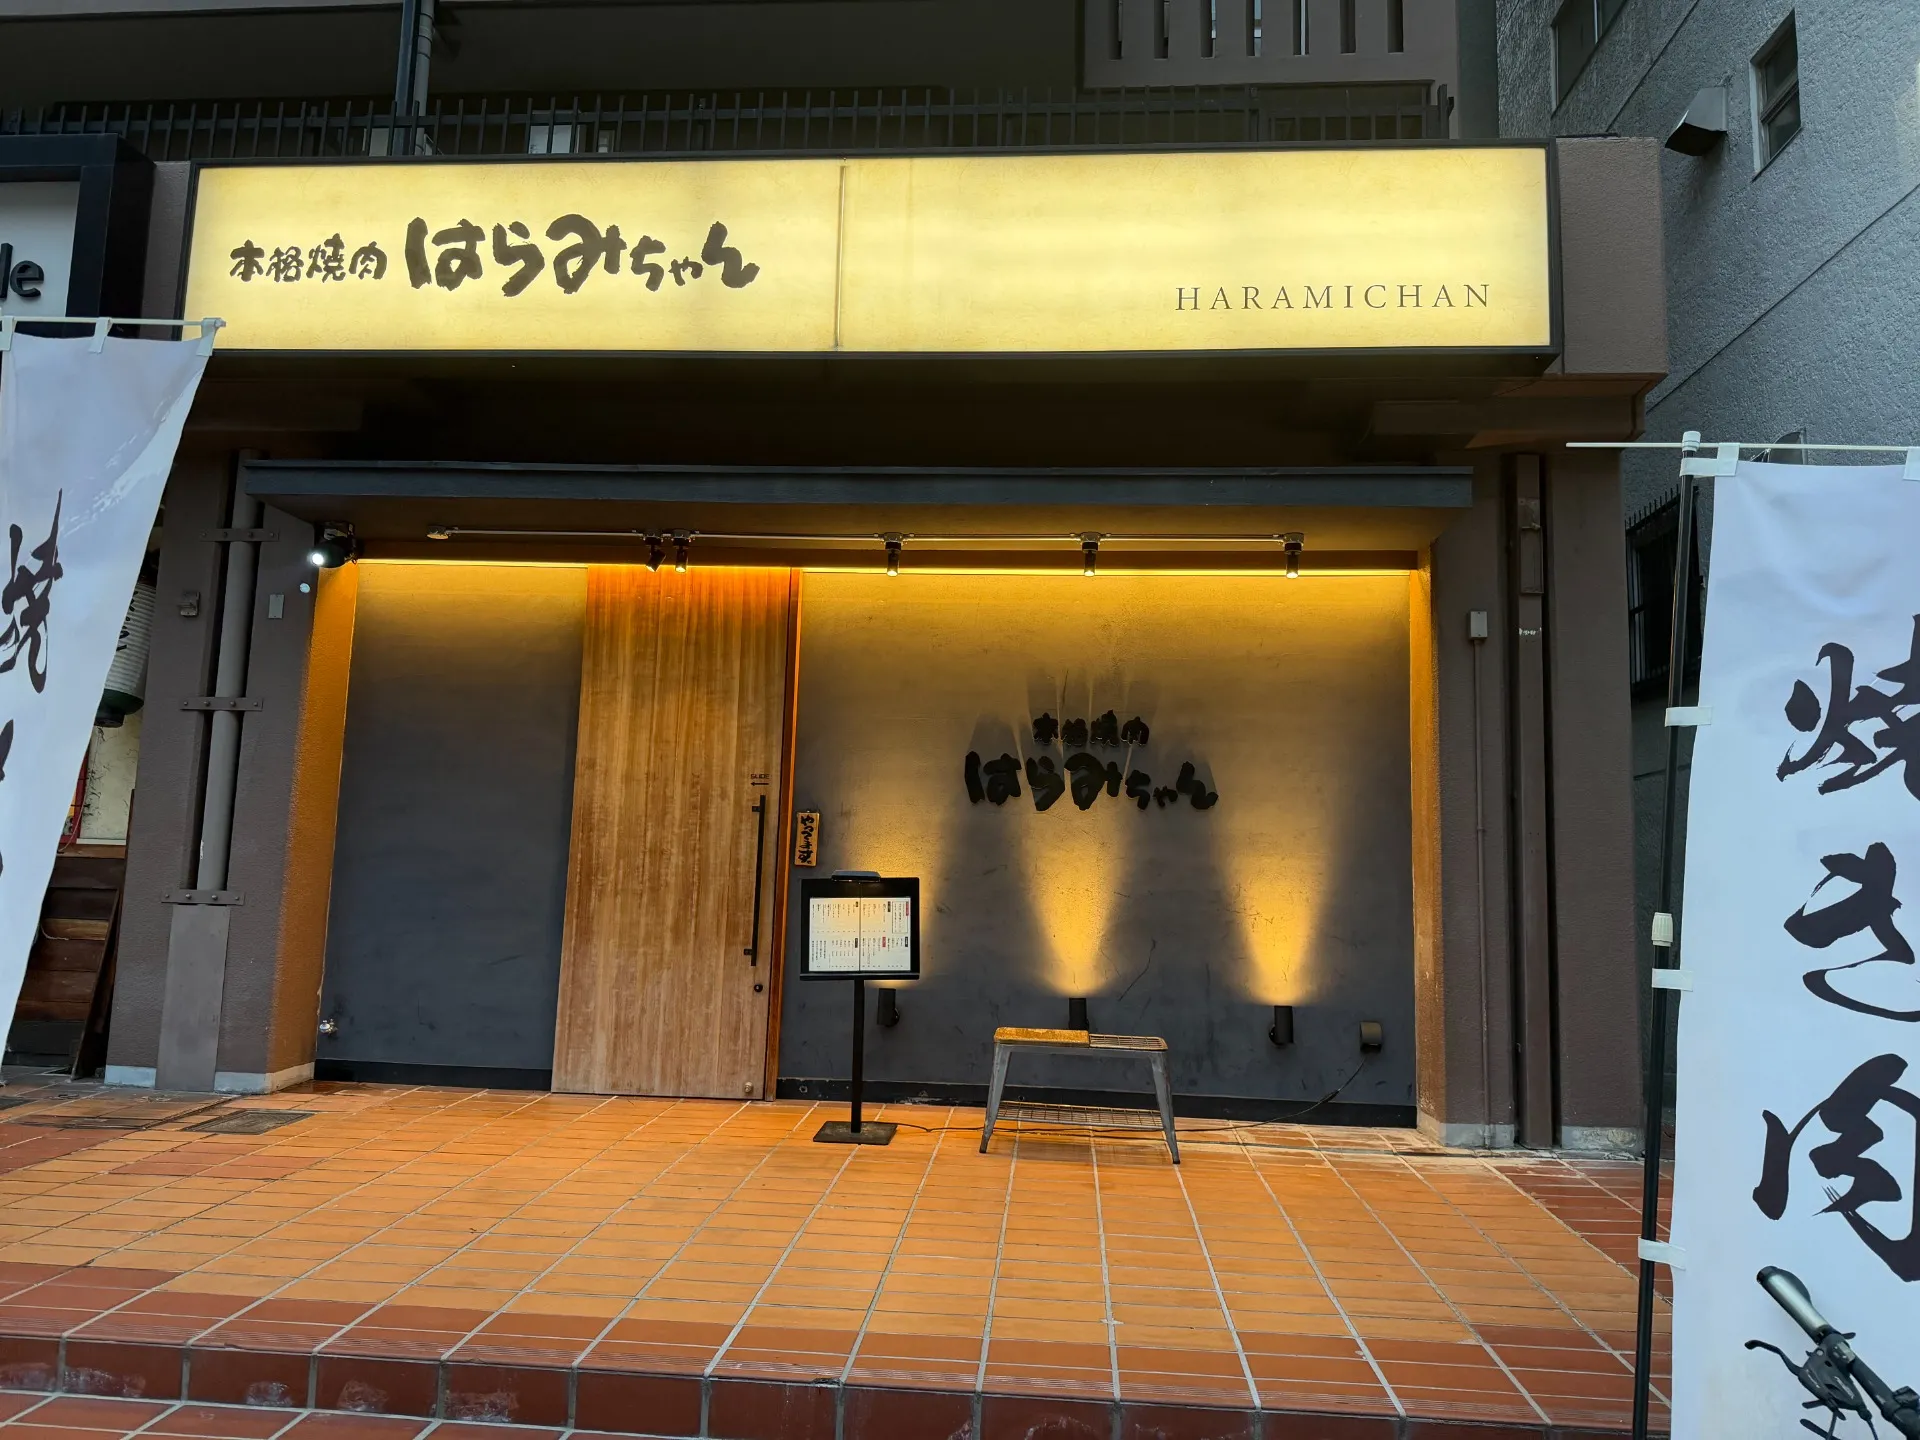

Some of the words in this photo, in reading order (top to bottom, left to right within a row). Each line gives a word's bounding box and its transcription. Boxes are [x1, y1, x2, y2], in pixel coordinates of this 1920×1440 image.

[229, 232, 388, 283] 本格焼肉
[404, 213, 760, 297] はらみちゃん
[1175, 283, 1490, 311] HARAMICHAN
[964, 751, 1219, 811] はらみちゃん
